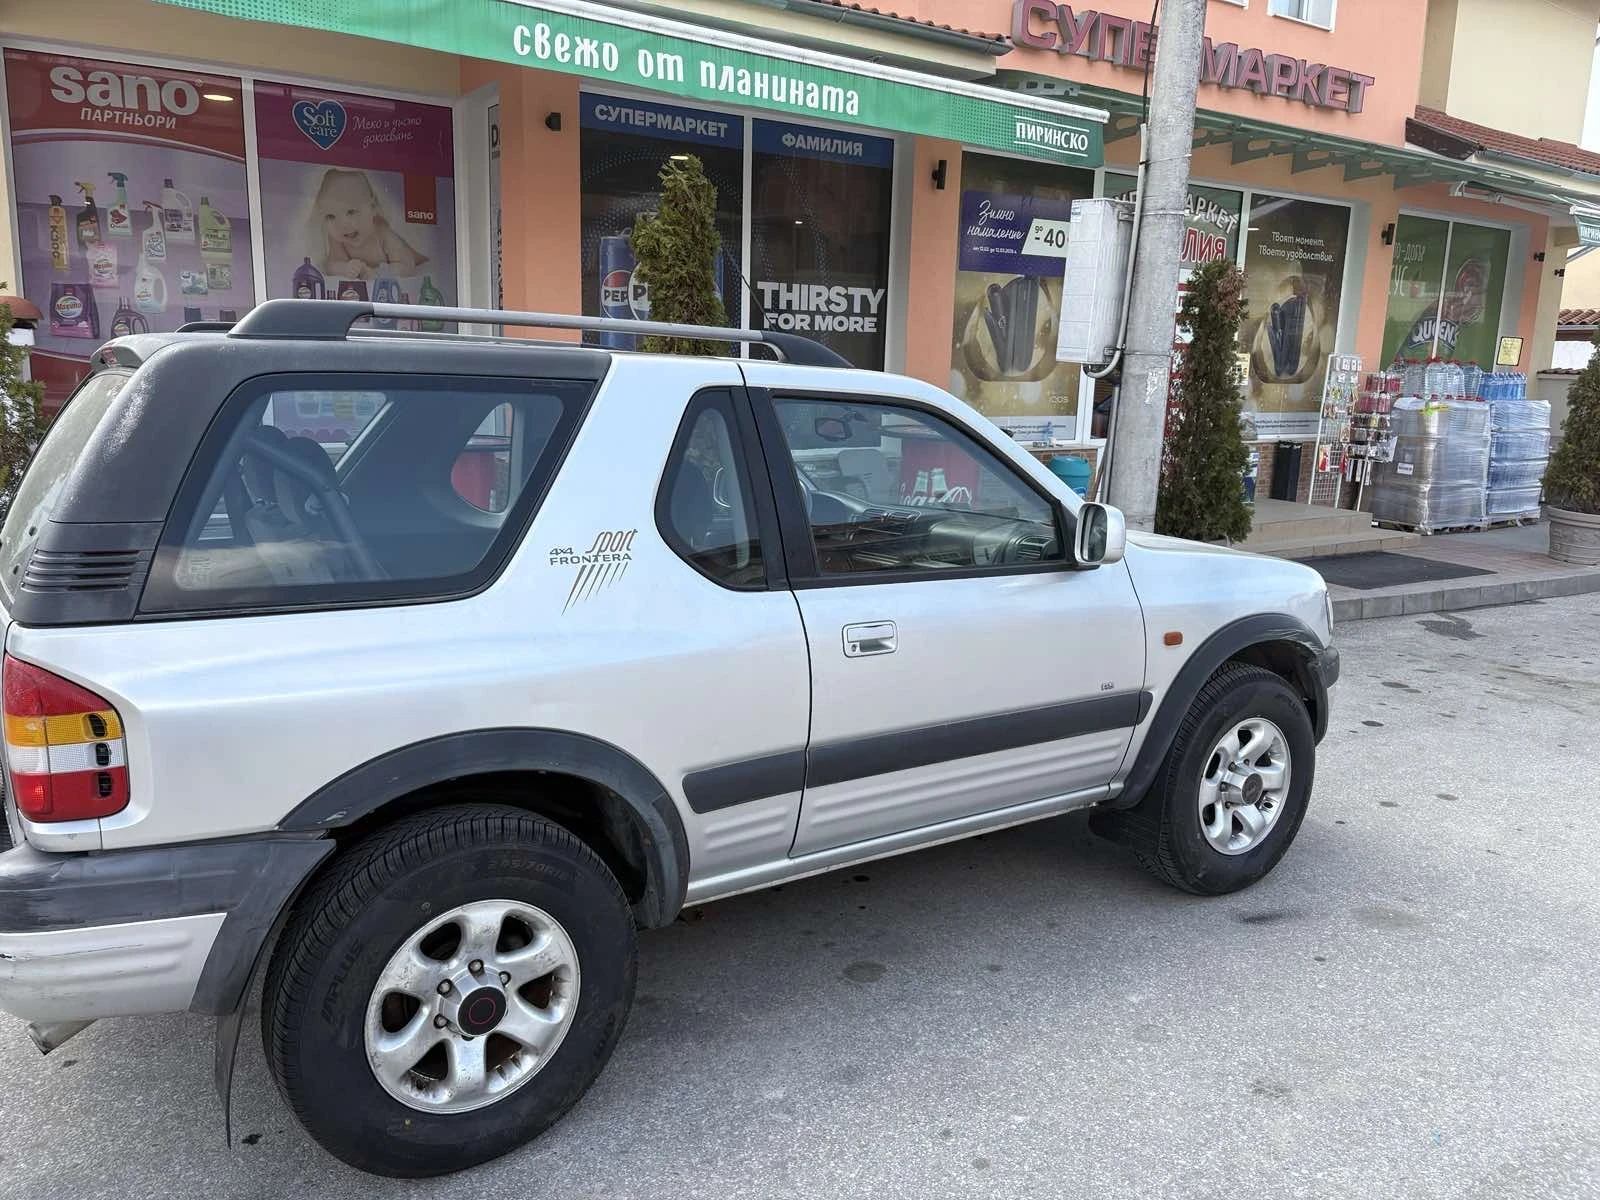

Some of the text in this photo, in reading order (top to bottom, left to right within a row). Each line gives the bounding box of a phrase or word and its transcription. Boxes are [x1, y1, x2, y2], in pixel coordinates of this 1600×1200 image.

[1012, 0, 1375, 113] СУПЕМАРКЕТ
[513, 22, 859, 116] свежо от планината
[50, 66, 200, 116] sano
[81, 107, 177, 129] ПАРТНЬОРИ
[302, 106, 337, 128] Soft
[594, 103, 728, 138] СУПЕРМАРКЕТ
[309, 126, 338, 138] care
[1015, 122, 1089, 151] ПИРИНСКО
[782, 132, 863, 157] ФАМИЛИЯ
[407, 209, 434, 220] sano
[979, 200, 1015, 226] Зимно
[1186, 193, 1239, 234] АРКЕТ
[967, 225, 1025, 240] намаление
[1271, 231, 1295, 244] Твоят
[1181, 227, 1227, 262] ЛИЯ
[1258, 244, 1286, 257] Твоето
[603, 289, 629, 303] PEP
[757, 281, 886, 314] THIRSTY
[763, 313, 877, 333] FOR MORE
[549, 553, 632, 566] FRONTERA
